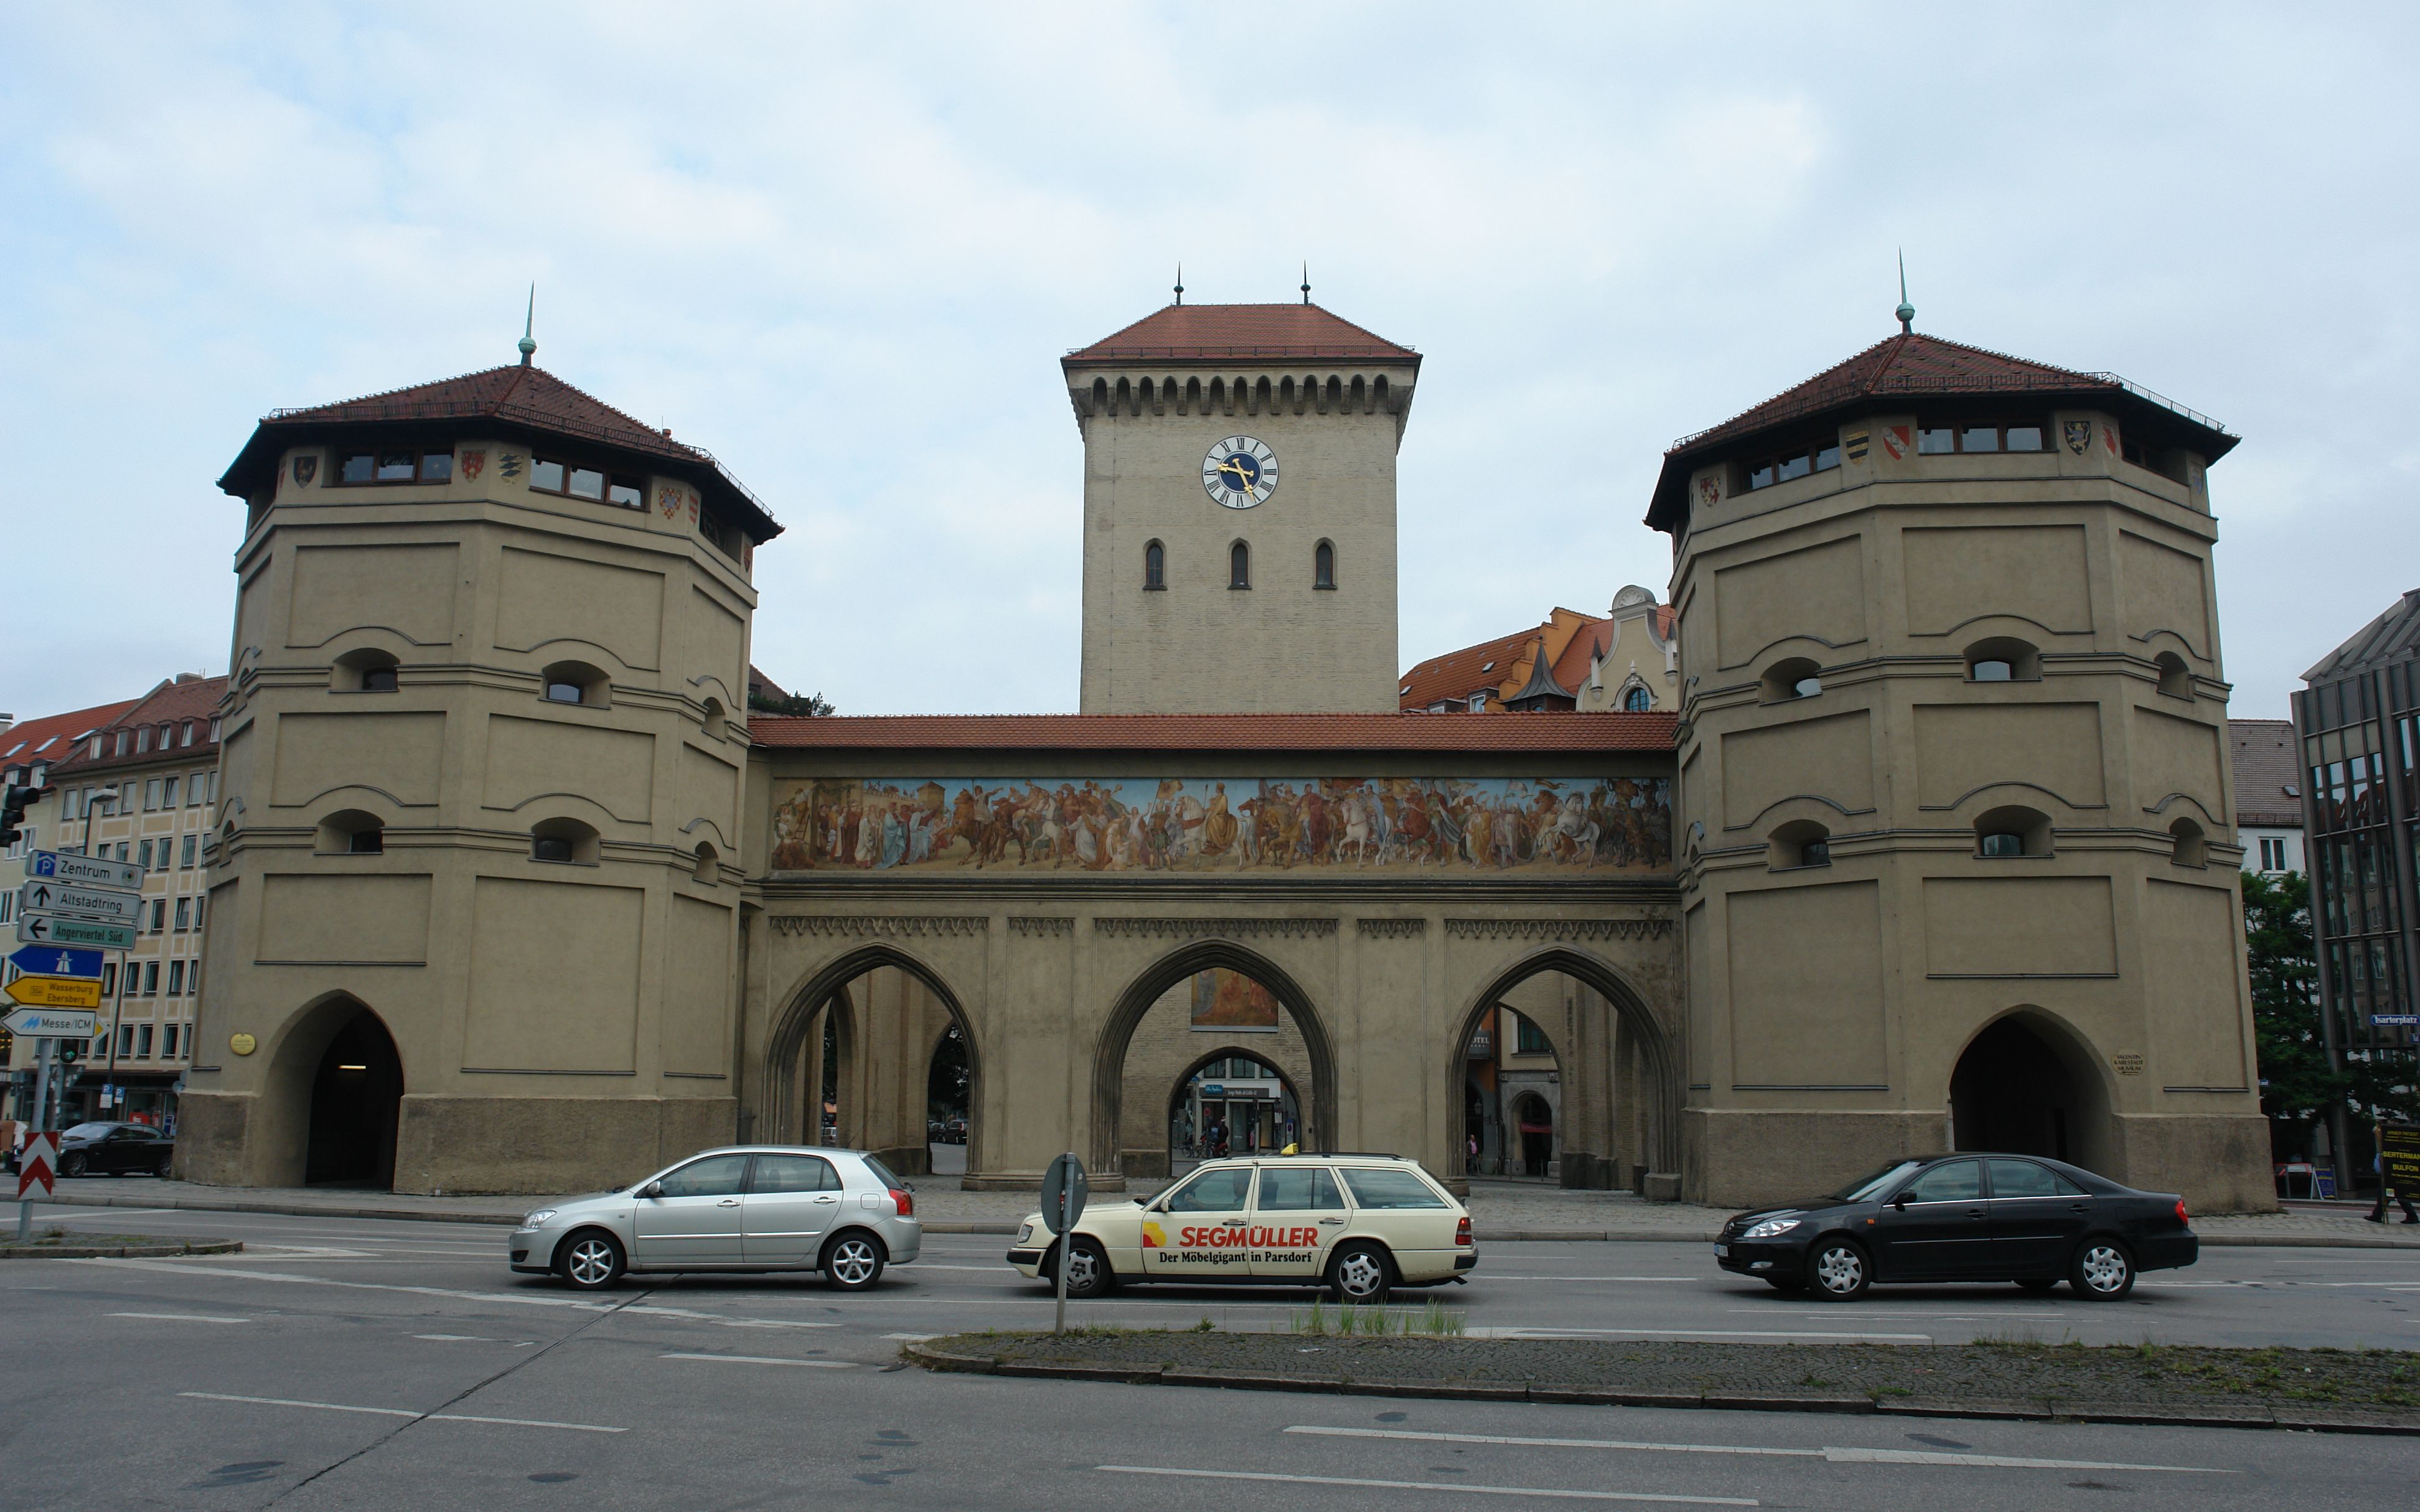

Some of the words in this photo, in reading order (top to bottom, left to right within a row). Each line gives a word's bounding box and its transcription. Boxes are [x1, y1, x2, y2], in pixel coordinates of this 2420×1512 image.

[60, 861, 110, 879] Zentrum
[60, 893, 122, 914] Altstadtring
[55, 925, 105, 941] Angerviertel
[109, 930, 123, 943] Süd
[49, 983, 93, 994] Wasserburg
[47, 994, 85, 1004] Ebersberg
[42, 1018, 91, 1029] Messe/ICM
[2375, 1015, 2418, 1025] Isartorplatz
[2392, 1164, 2419, 1172] BULFON
[1179, 1226, 1318, 1248] SEGMÜLLER
[1159, 1251, 1178, 1262] Der
[1181, 1251, 1246, 1264] Möbelgigant
[1250, 1251, 1262, 1262] in
[1265, 1251, 1312, 1262] Parsdorf
